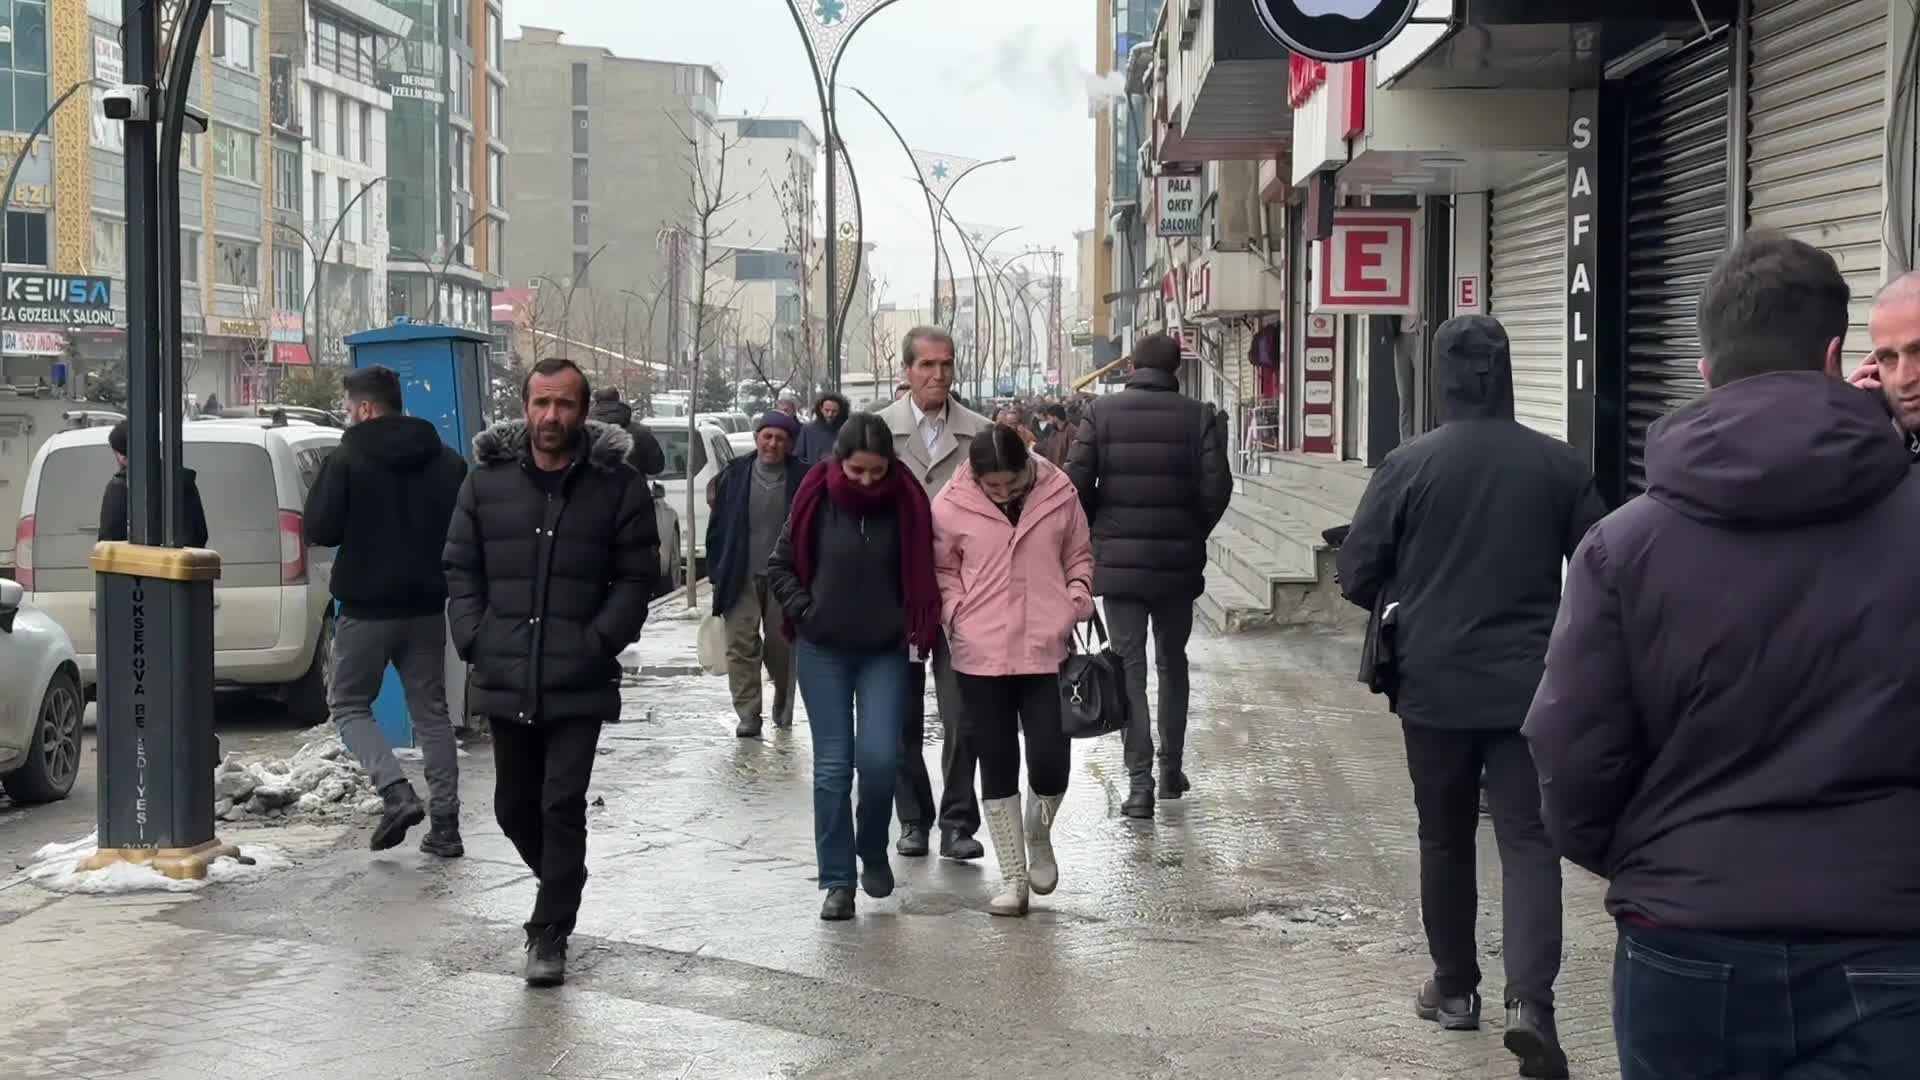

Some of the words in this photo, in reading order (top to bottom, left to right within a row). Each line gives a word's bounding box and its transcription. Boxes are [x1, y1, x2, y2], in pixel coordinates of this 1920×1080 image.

[1168, 179, 1191, 192] PALA
[1167, 199, 1193, 212] OKEY
[1160, 218, 1200, 233] SALONU
[1344, 231, 1388, 291] E
[1570, 117, 1592, 390] SAFALI
[1462, 280, 1473, 303] E
[73, 308, 116, 325] SALONU
